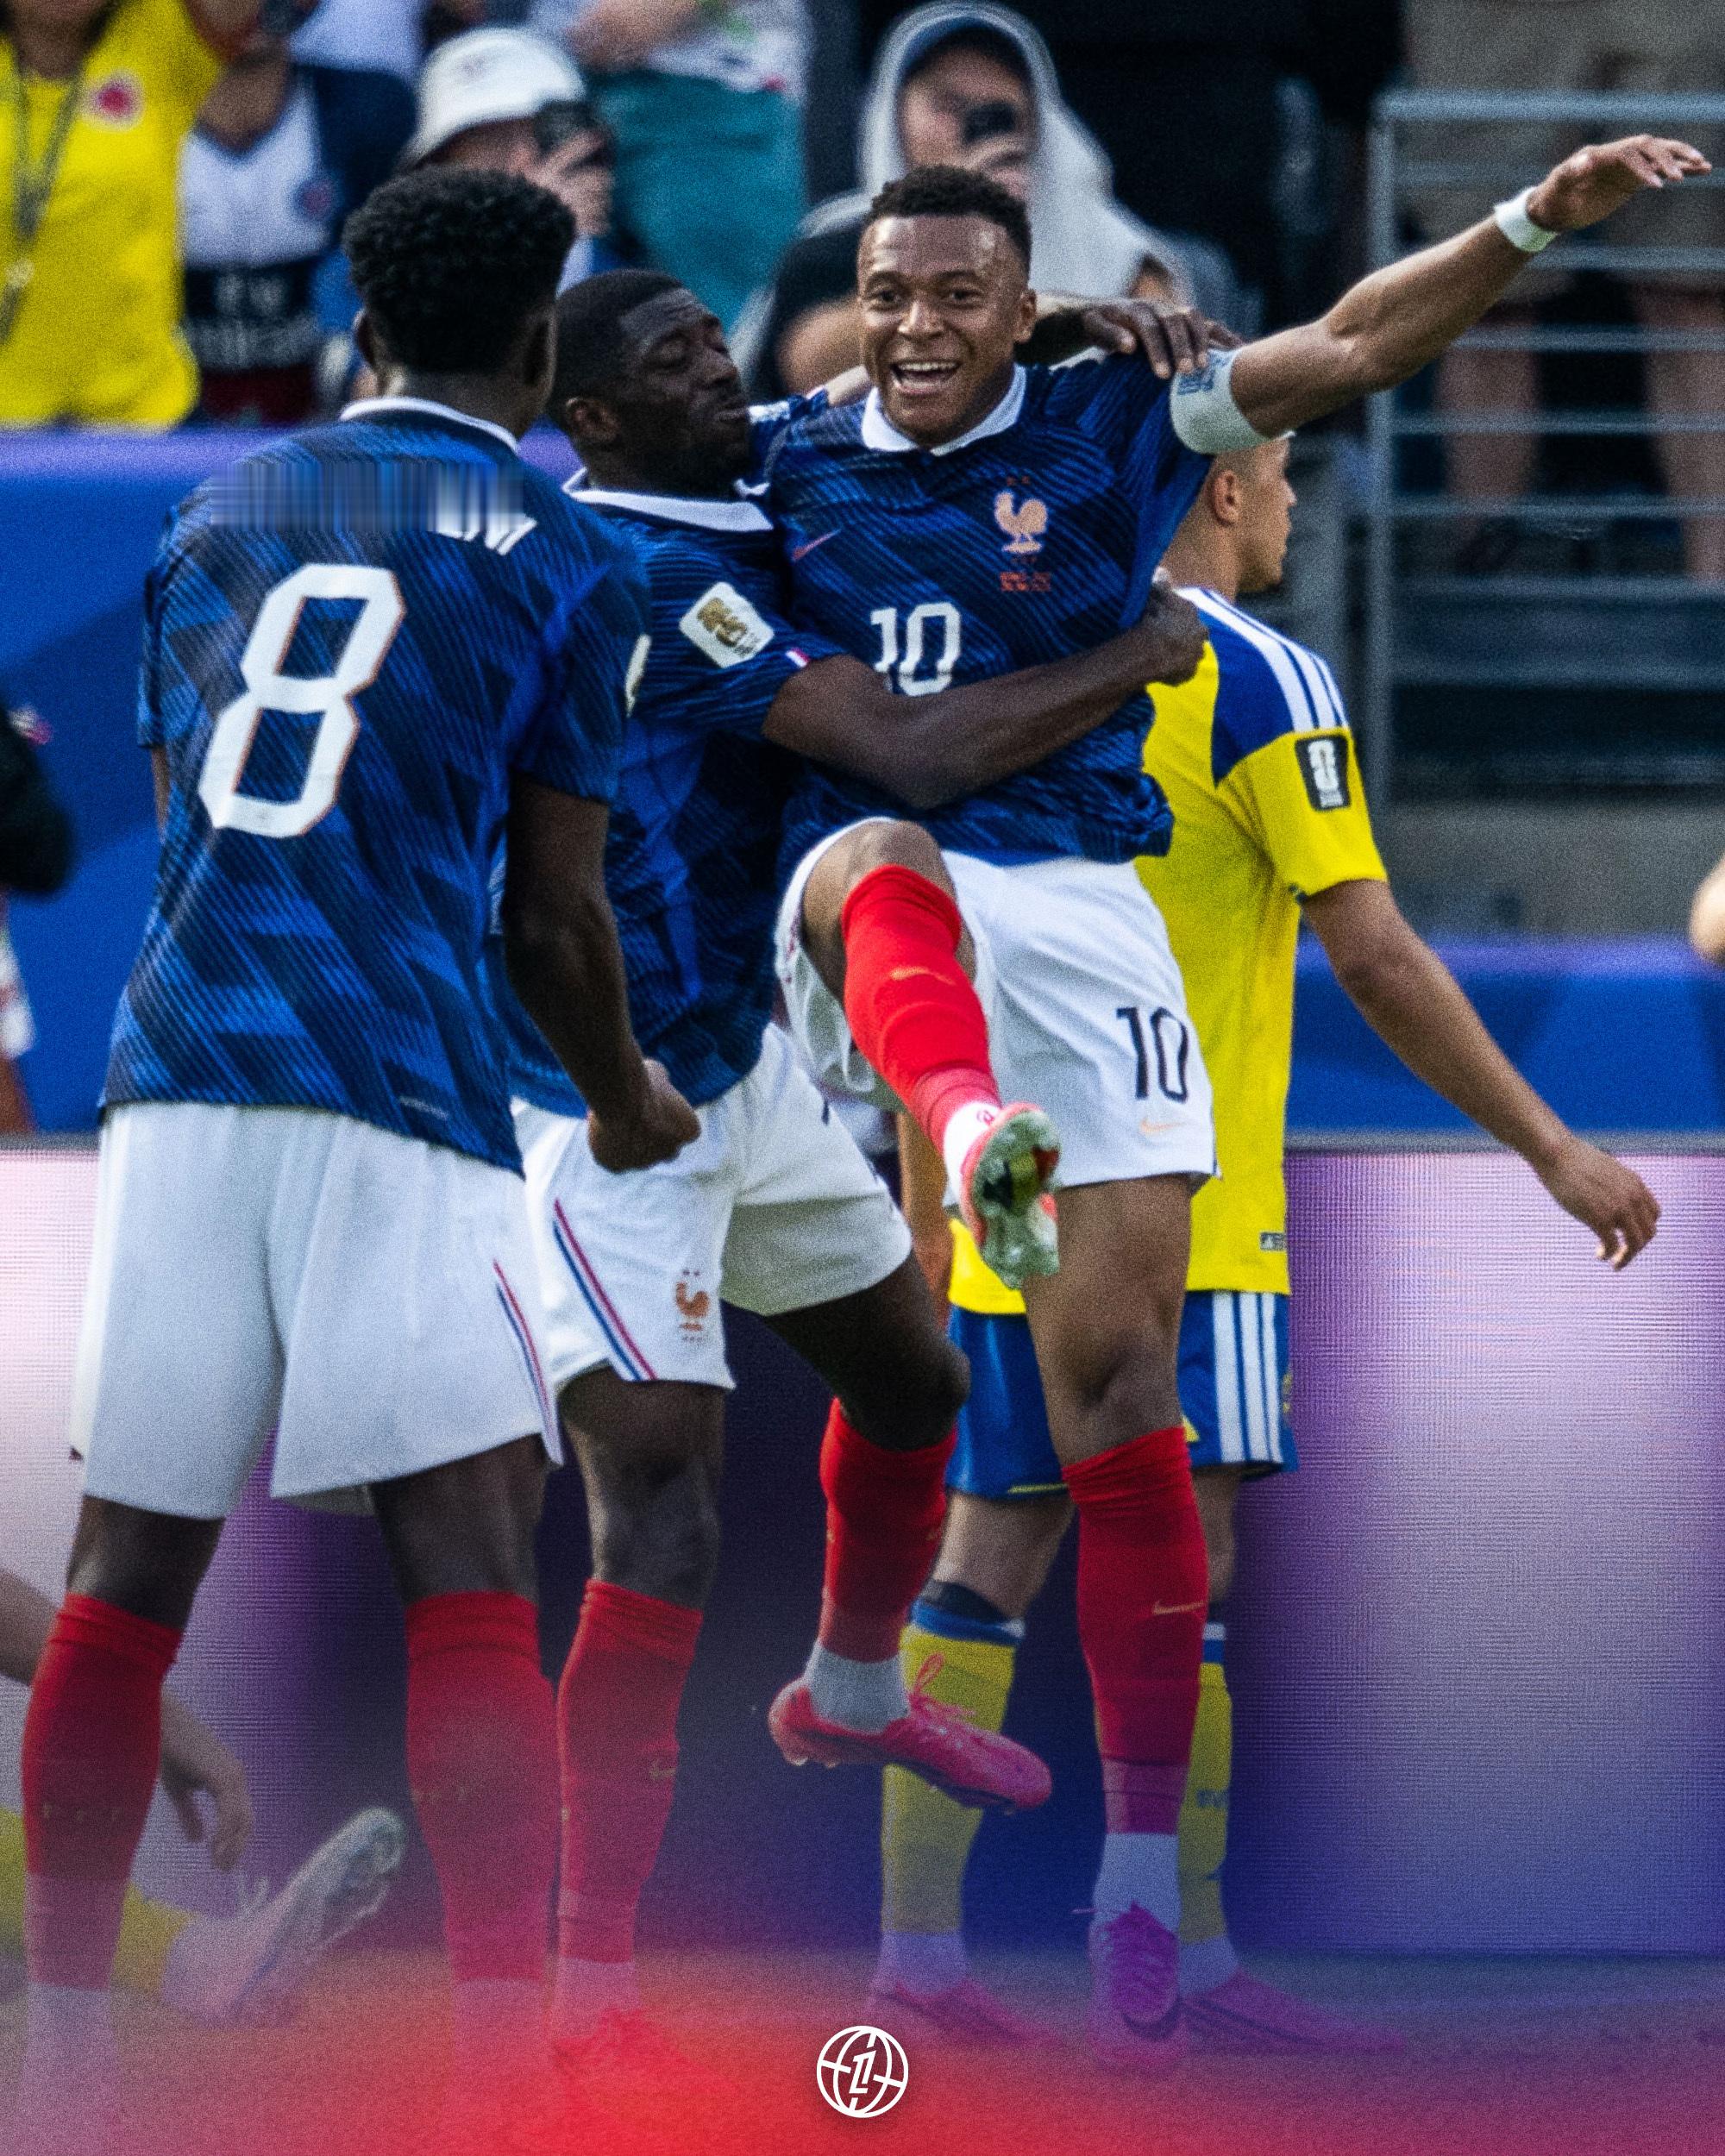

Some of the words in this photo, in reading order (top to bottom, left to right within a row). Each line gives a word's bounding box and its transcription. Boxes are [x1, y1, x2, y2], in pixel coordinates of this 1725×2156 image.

[870, 602, 961, 697] 10
[198, 562, 407, 838] 8
[1116, 1006, 1189, 1103] 10
